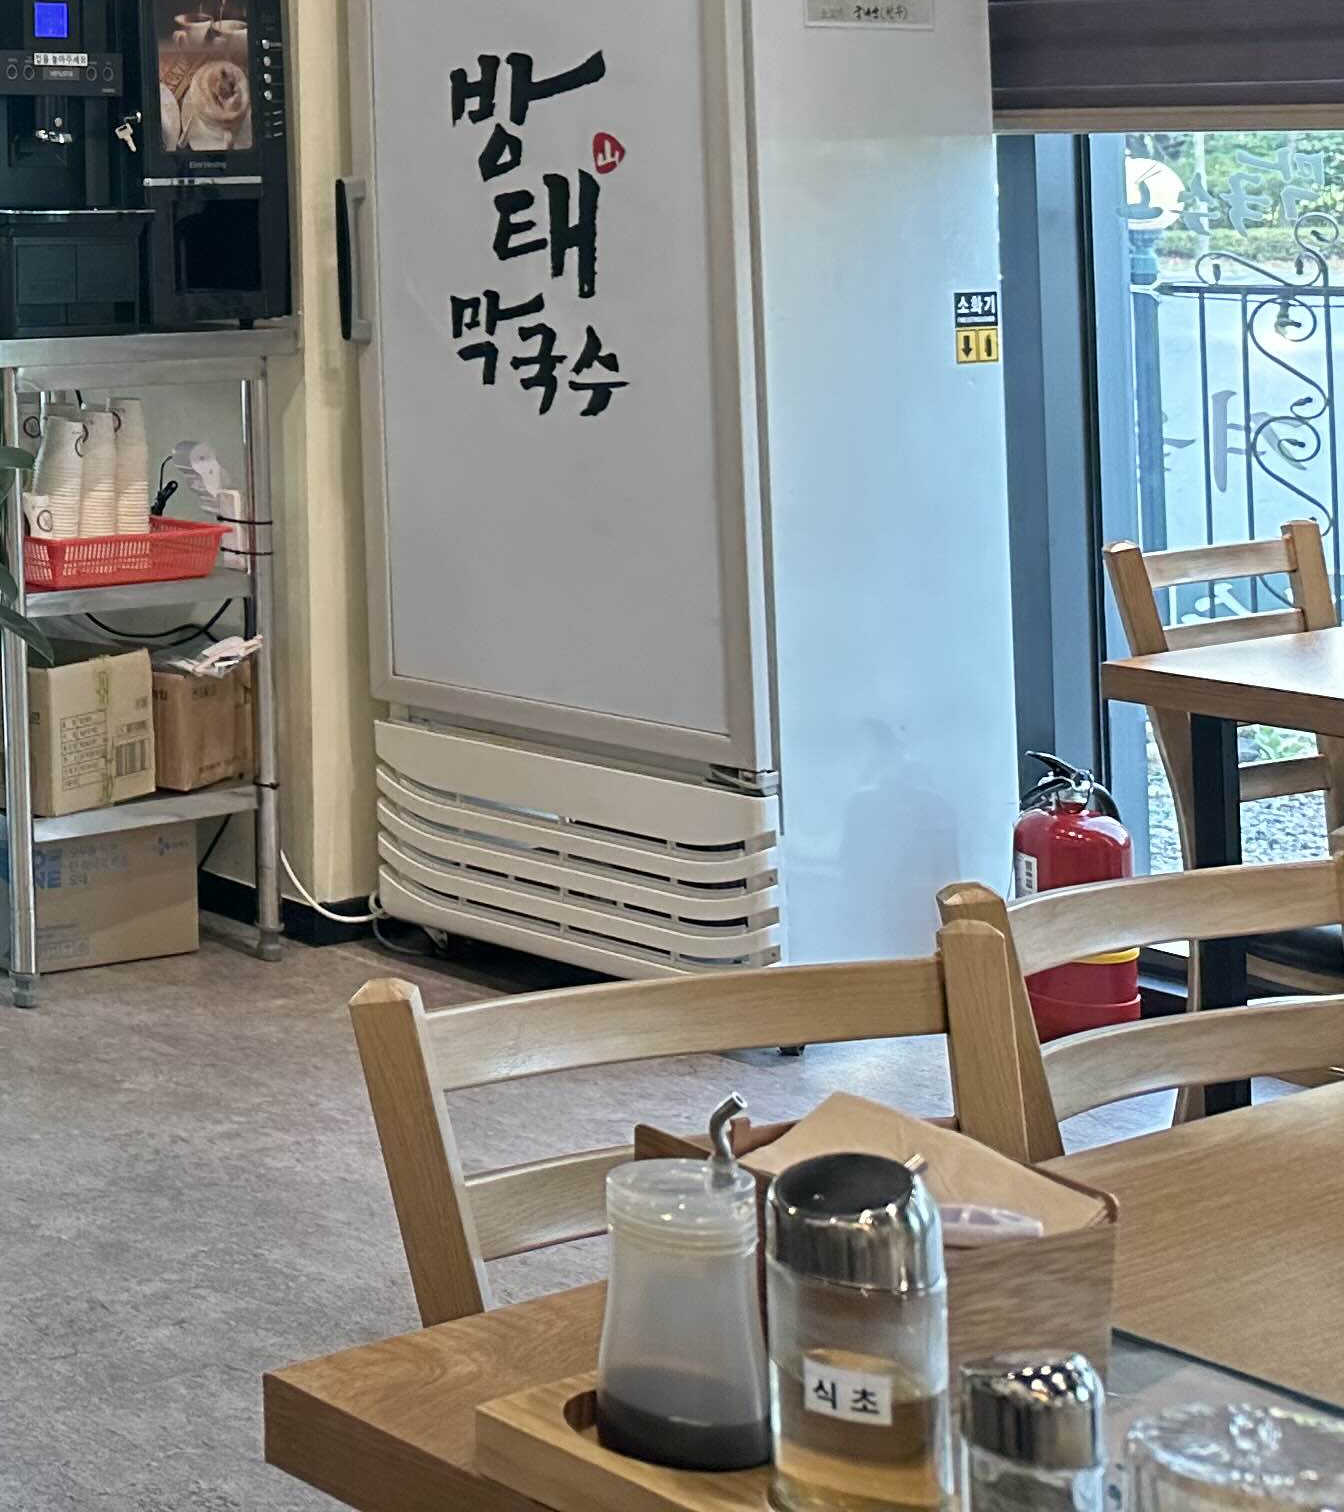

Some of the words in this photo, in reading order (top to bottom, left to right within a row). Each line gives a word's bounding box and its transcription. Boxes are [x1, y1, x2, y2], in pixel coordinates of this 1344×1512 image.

[449, 49, 606, 298] 방태
[957, 294, 996, 314] 소화기
[449, 288, 630, 417] 막국수
[813, 1380, 880, 1414] 식초
